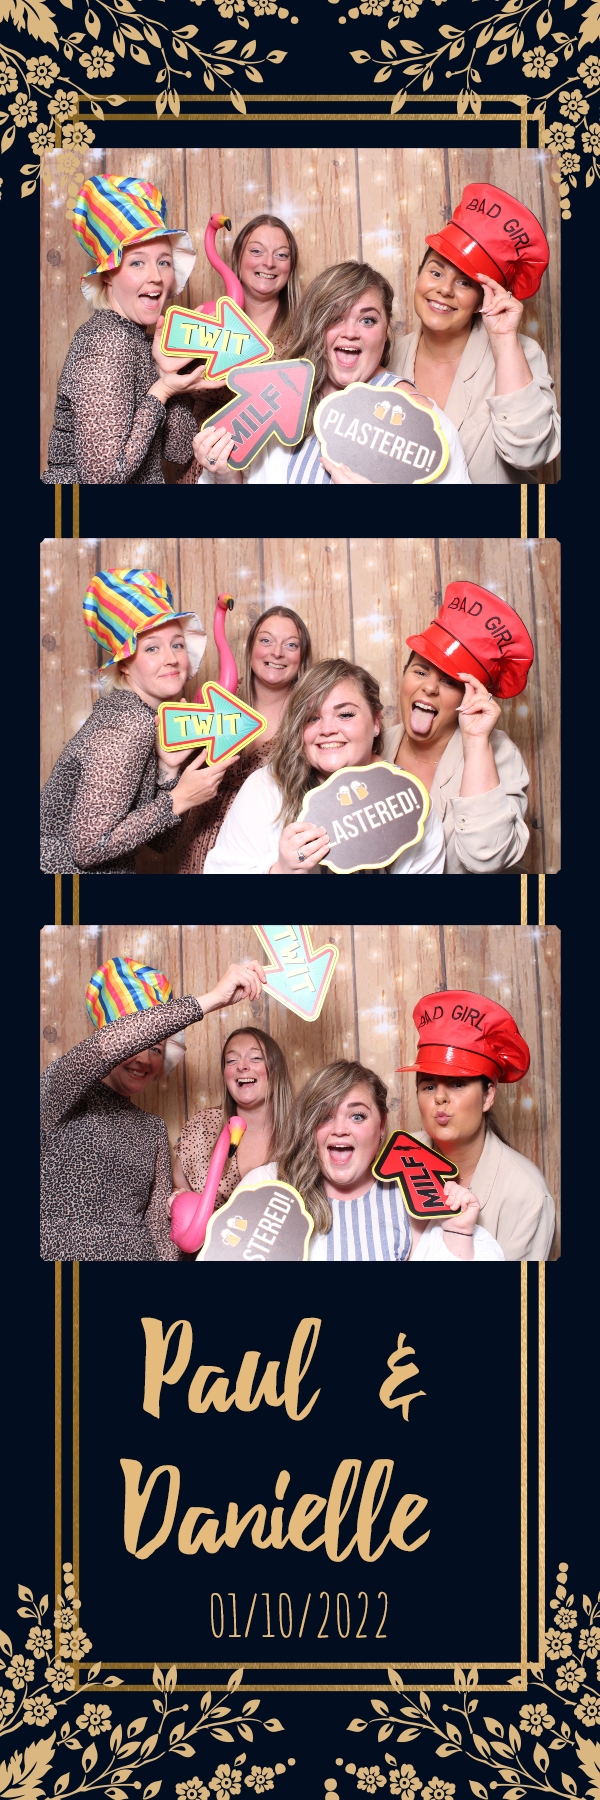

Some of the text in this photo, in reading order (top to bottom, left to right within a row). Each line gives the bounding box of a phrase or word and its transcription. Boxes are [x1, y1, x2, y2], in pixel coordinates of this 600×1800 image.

[466, 198, 533, 257] BAD GIRL
[180, 322, 251, 355] TWIT
[231, 383, 281, 452] MILF
[322, 408, 436, 472] PLASTERED!
[447, 596, 516, 654] BAD GIRL
[174, 712, 243, 737] TWIT
[273, 925, 317, 993] TWIT
[418, 1004, 486, 1032] BAD GIRL
[400, 1156, 445, 1208] MILF
